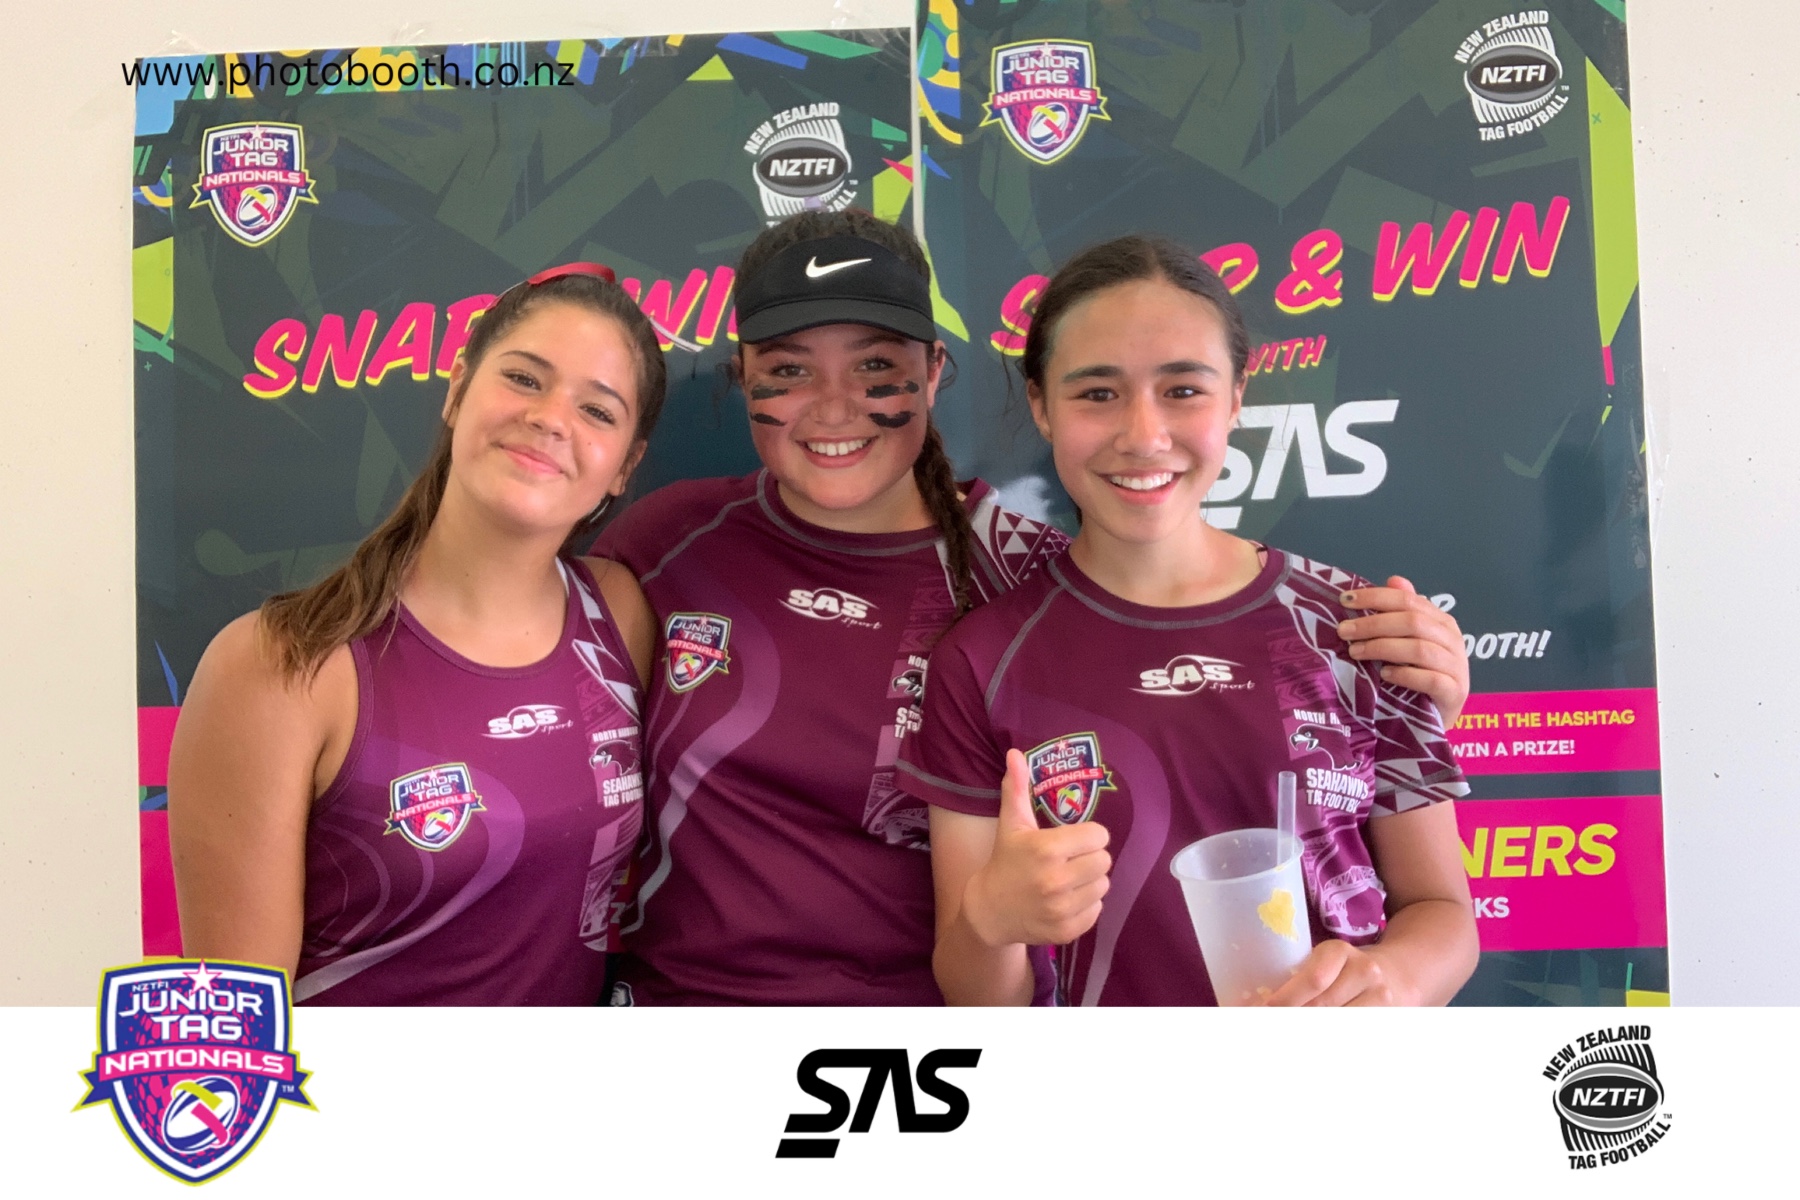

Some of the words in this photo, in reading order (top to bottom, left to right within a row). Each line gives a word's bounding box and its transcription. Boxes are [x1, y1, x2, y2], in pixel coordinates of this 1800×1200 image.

[1454, 30, 1484, 64] NEW
[1482, 10, 1549, 37] ZEALAND
[1003, 55, 1080, 74] JUNIOR
[1020, 69, 1070, 85] TAG
[1480, 65, 1547, 84] NZTFI
[996, 88, 1092, 106] NATIONALS
[1478, 126, 1505, 141] TAG
[1506, 94, 1569, 137] FOOTBALL
[743, 120, 775, 155] NEW
[772, 102, 840, 129] ZEALAND
[213, 137, 289, 156] JUNIOR
[229, 151, 279, 168] TAG
[769, 158, 836, 177] NZTFI
[206, 170, 301, 187] NATIONALS
[1274, 228, 1343, 315] &
[1372, 196, 1571, 302] WIN
[788, 589, 868, 619] SAS
[673, 621, 721, 636] JUNIOR
[841, 617, 882, 630] sport
[683, 629, 712, 645] TAG
[1462, 629, 1552, 660] OOTH!
[908, 654, 928, 670] NOR
[1139, 664, 1233, 688] SAS
[1209, 680, 1256, 693] sport
[487, 709, 559, 734] SAS
[1293, 708, 1326, 725] NORTH
[1504, 712, 1542, 728] THE
[1547, 709, 1635, 727] HASHTAG
[541, 719, 574, 735] sport
[1032, 745, 1087, 769] JUNIOR
[1450, 742, 1489, 758] WIN
[1494, 742, 1508, 756] A
[1512, 739, 1575, 756] PRIZE!
[1044, 757, 1080, 775] TAG
[400, 774, 460, 798] JUNIOR
[413, 784, 452, 801] TAG
[395, 795, 472, 820] NATIONALS
[603, 794, 619, 808] TAG
[1459, 823, 1619, 879] NERS
